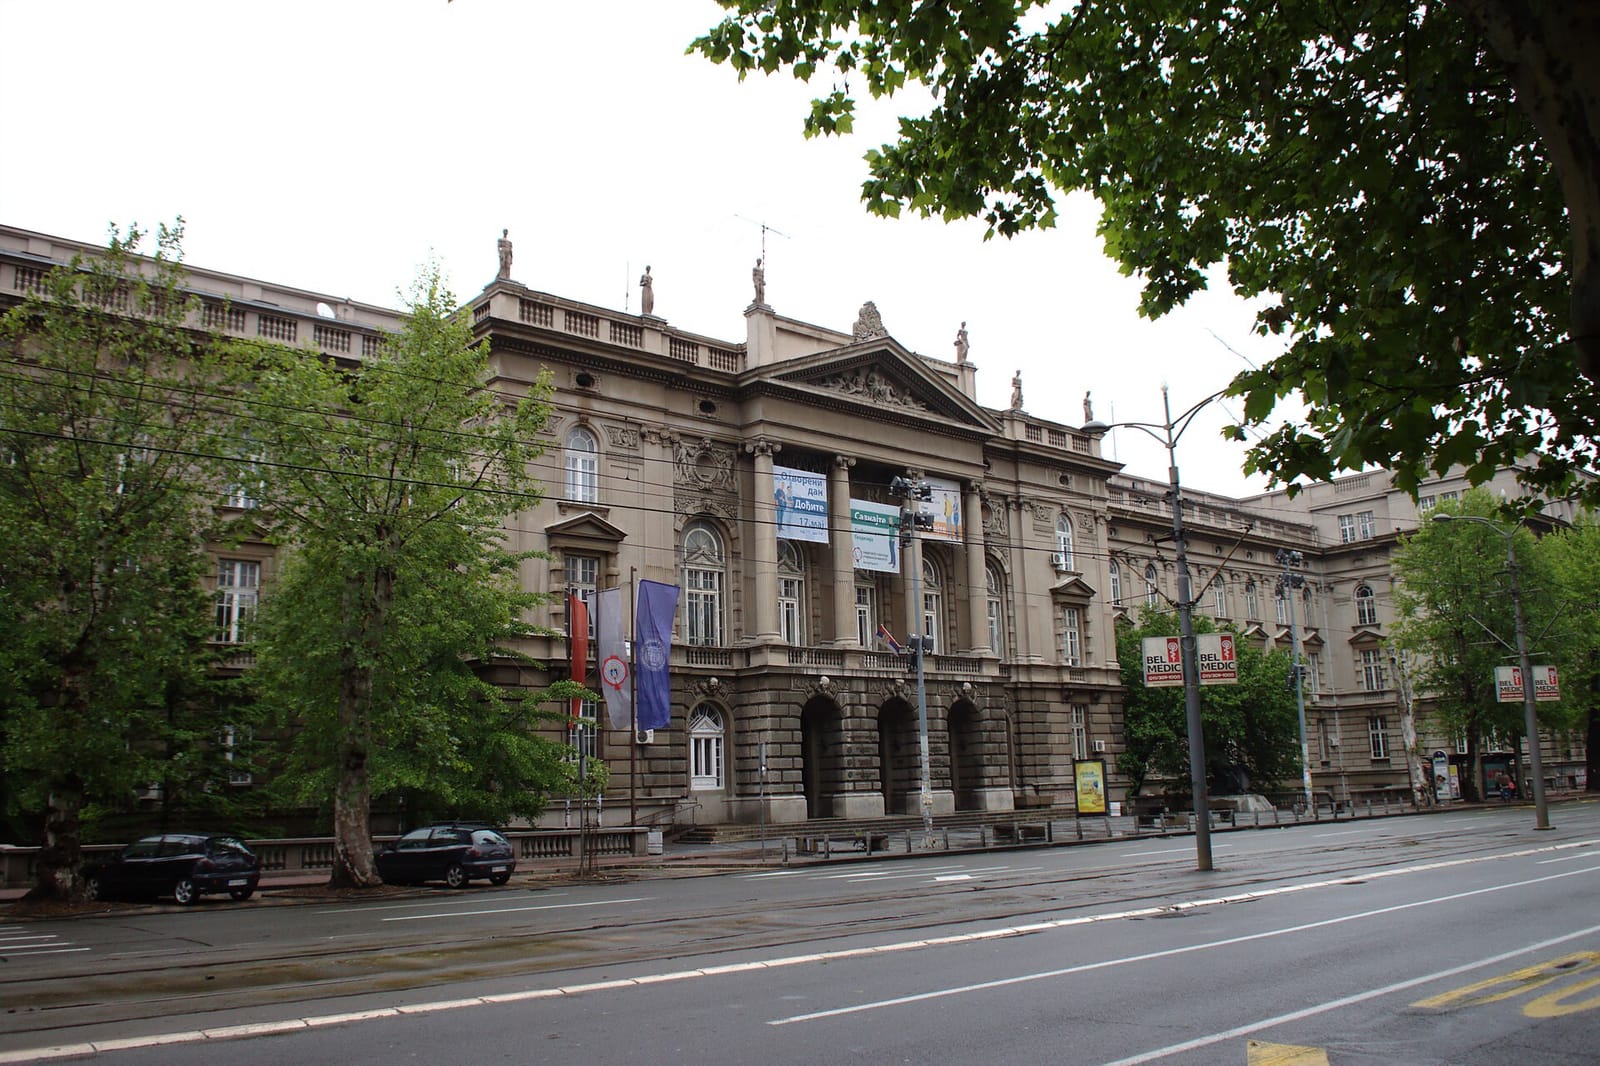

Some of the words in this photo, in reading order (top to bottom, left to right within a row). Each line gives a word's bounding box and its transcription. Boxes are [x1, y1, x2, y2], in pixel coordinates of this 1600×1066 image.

[781, 471, 823, 487] Отворени
[807, 487, 824, 497] дан
[794, 499, 825, 512] Дођите
[1146, 656, 1166, 664] BEL
[1147, 663, 1181, 673] MEDIC
[1201, 661, 1235, 671] MEDIC
